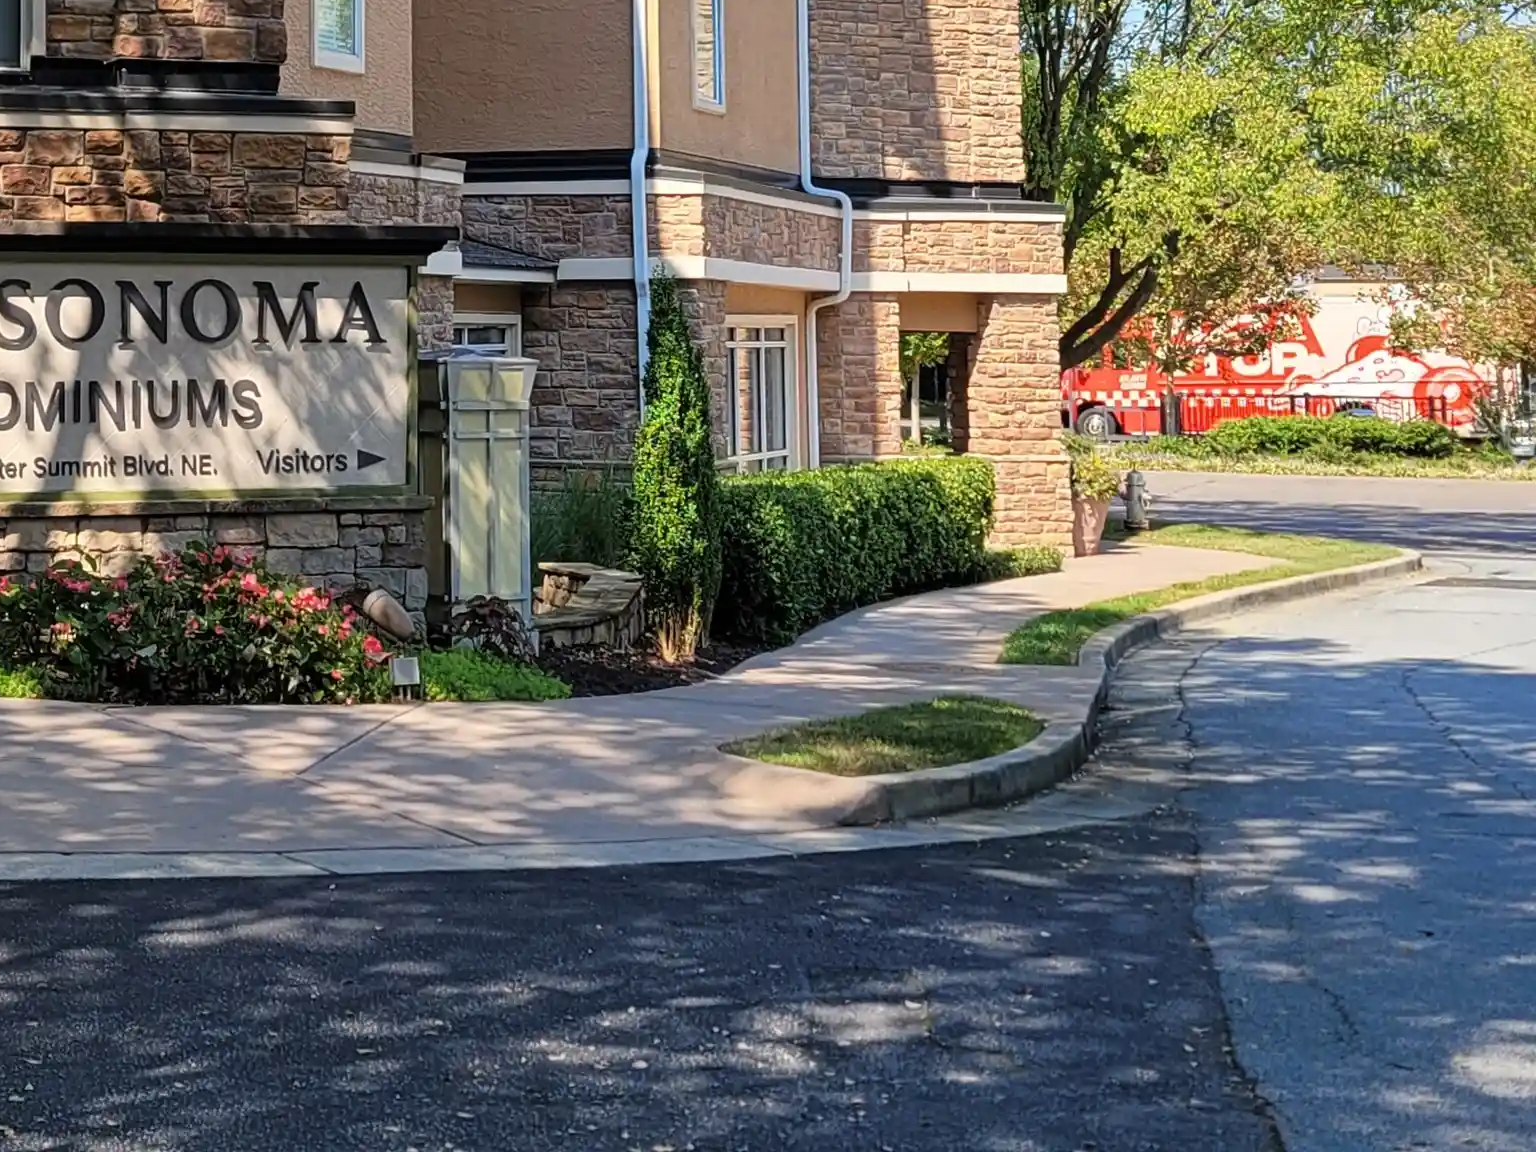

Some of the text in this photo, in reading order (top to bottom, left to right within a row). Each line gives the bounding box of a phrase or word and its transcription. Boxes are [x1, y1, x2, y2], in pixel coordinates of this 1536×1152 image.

[33, 455, 116, 478] Summit
[124, 453, 174, 476] Blvd.
[182, 454, 218, 476] NE.
[256, 448, 348, 474] Visitors
